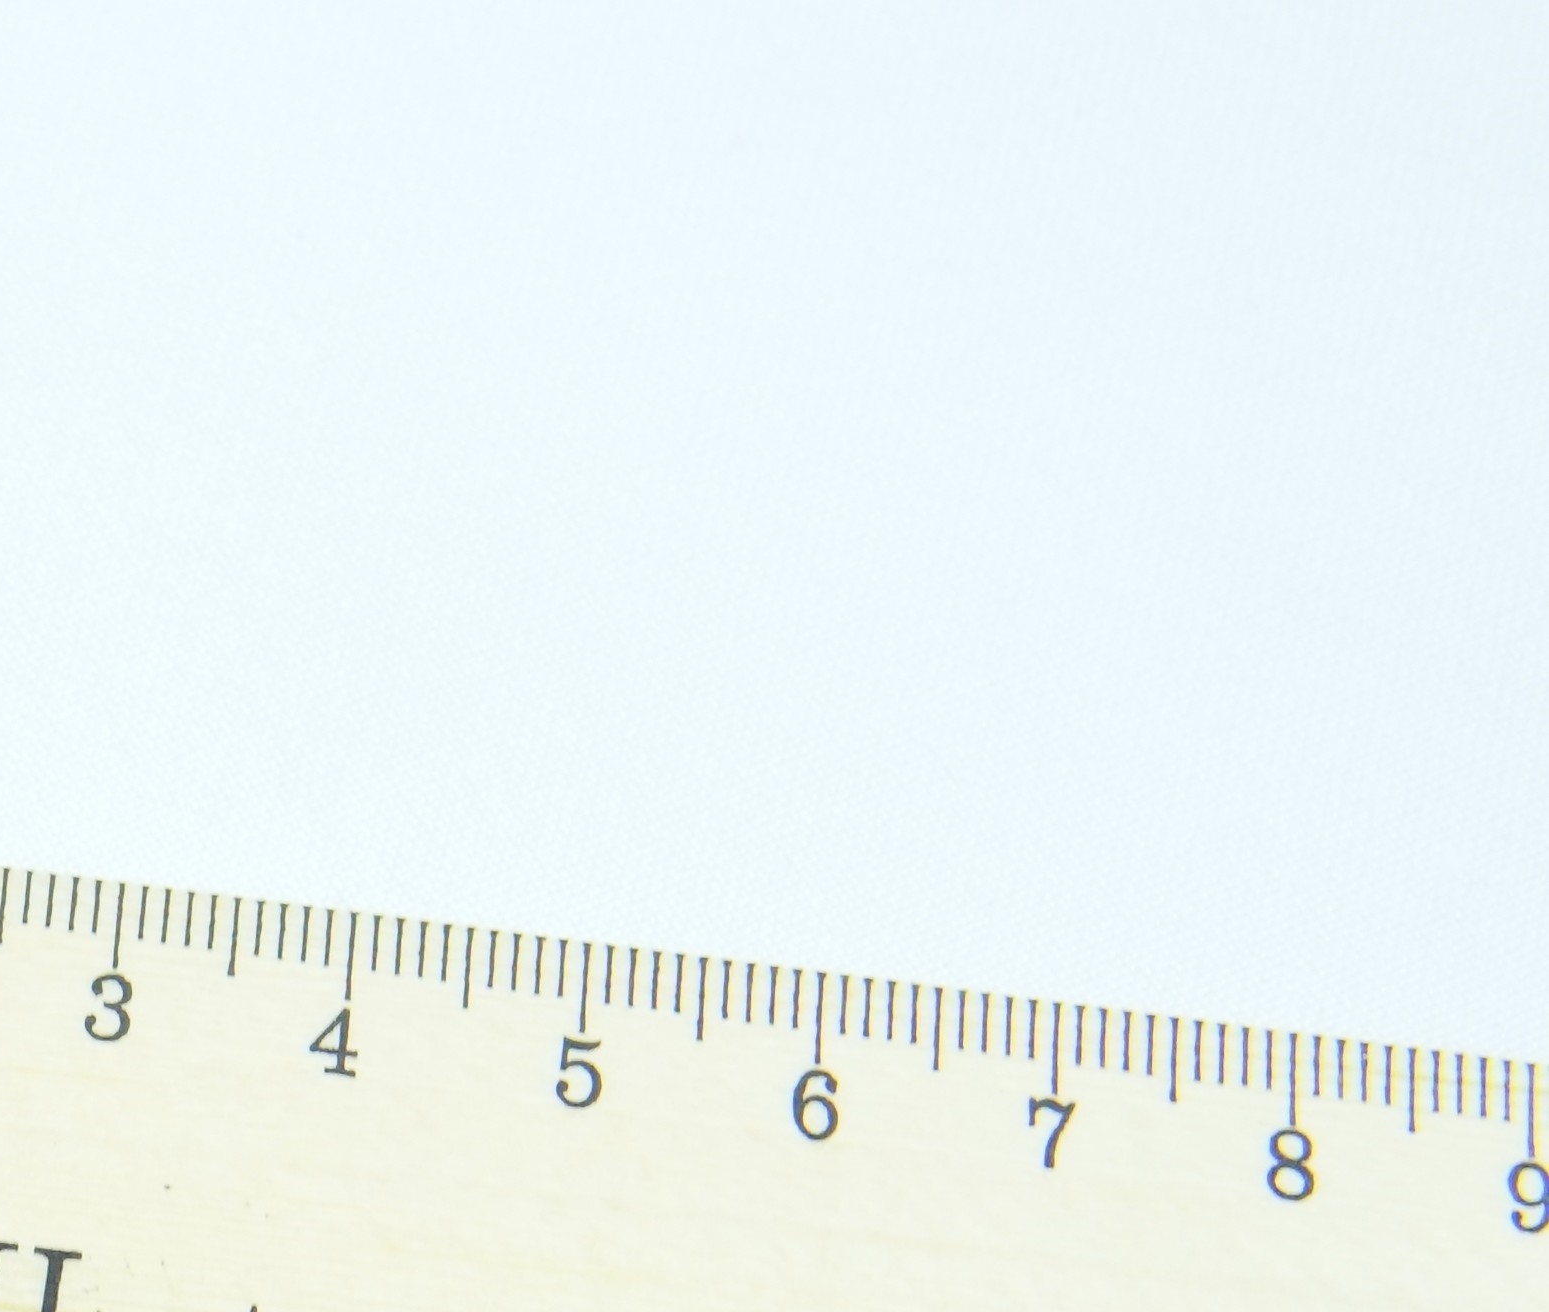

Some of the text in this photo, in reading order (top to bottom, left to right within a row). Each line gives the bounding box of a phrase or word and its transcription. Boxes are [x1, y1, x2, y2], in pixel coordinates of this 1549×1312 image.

[84, 976, 132, 1042] 3
[309, 1009, 358, 1077] 4
[555, 1039, 604, 1107] 5
[793, 1069, 839, 1140] 6
[1028, 1099, 1076, 1168] 7
[1267, 1129, 1314, 1202] 8
[1506, 1163, 1549, 1234] 9
